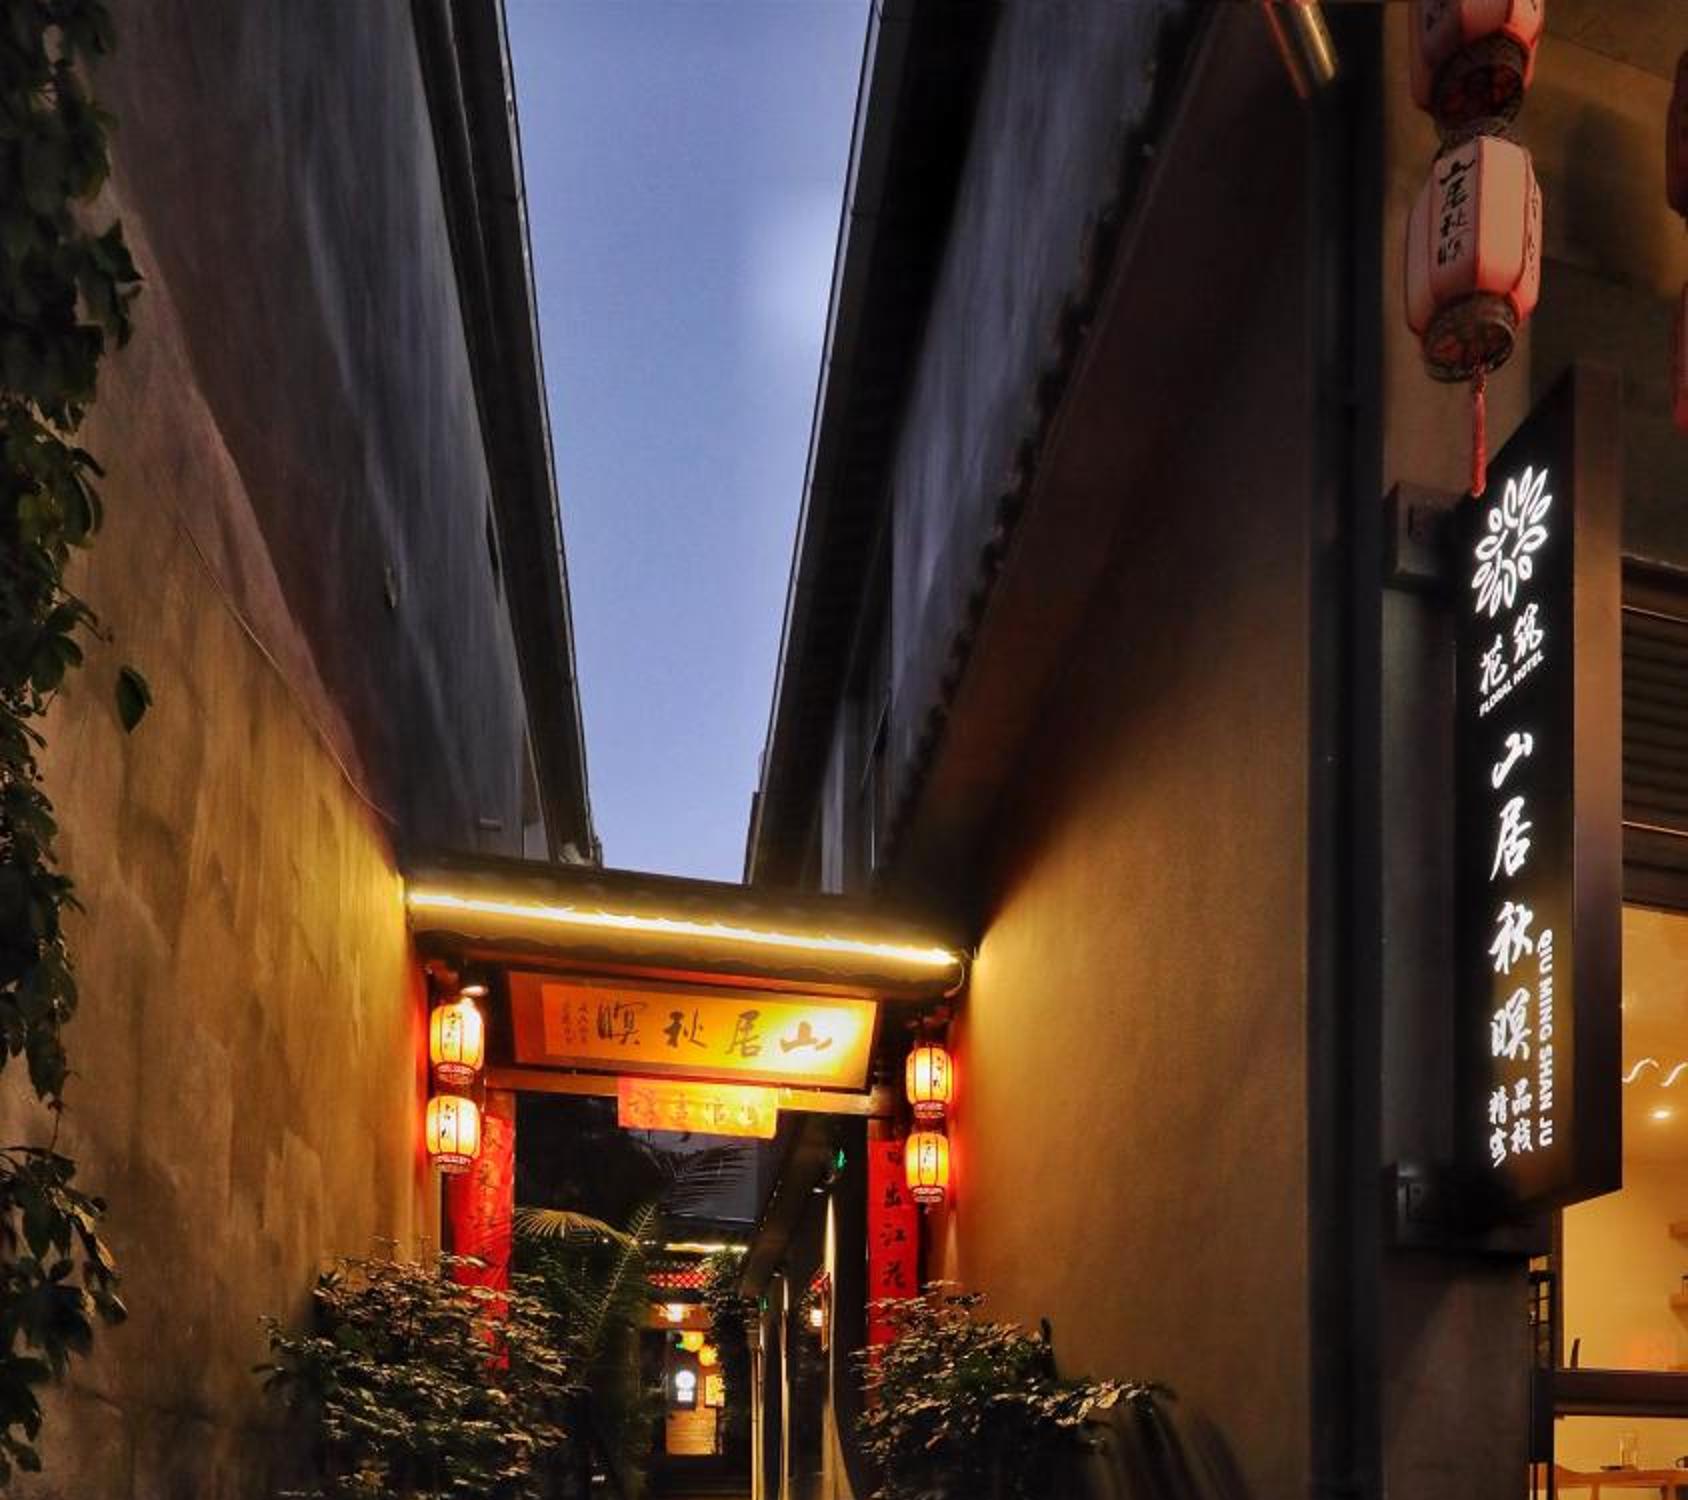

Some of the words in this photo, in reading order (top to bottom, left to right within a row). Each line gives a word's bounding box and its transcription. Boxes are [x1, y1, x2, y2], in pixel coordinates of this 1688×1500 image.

[1513, 649, 1545, 686] HOTEL
[1537, 928, 1553, 974] QIU
[1539, 976, 1553, 1042] MING
[1539, 1044, 1553, 1111] SHAN
[1539, 1116, 1553, 1147] JU
